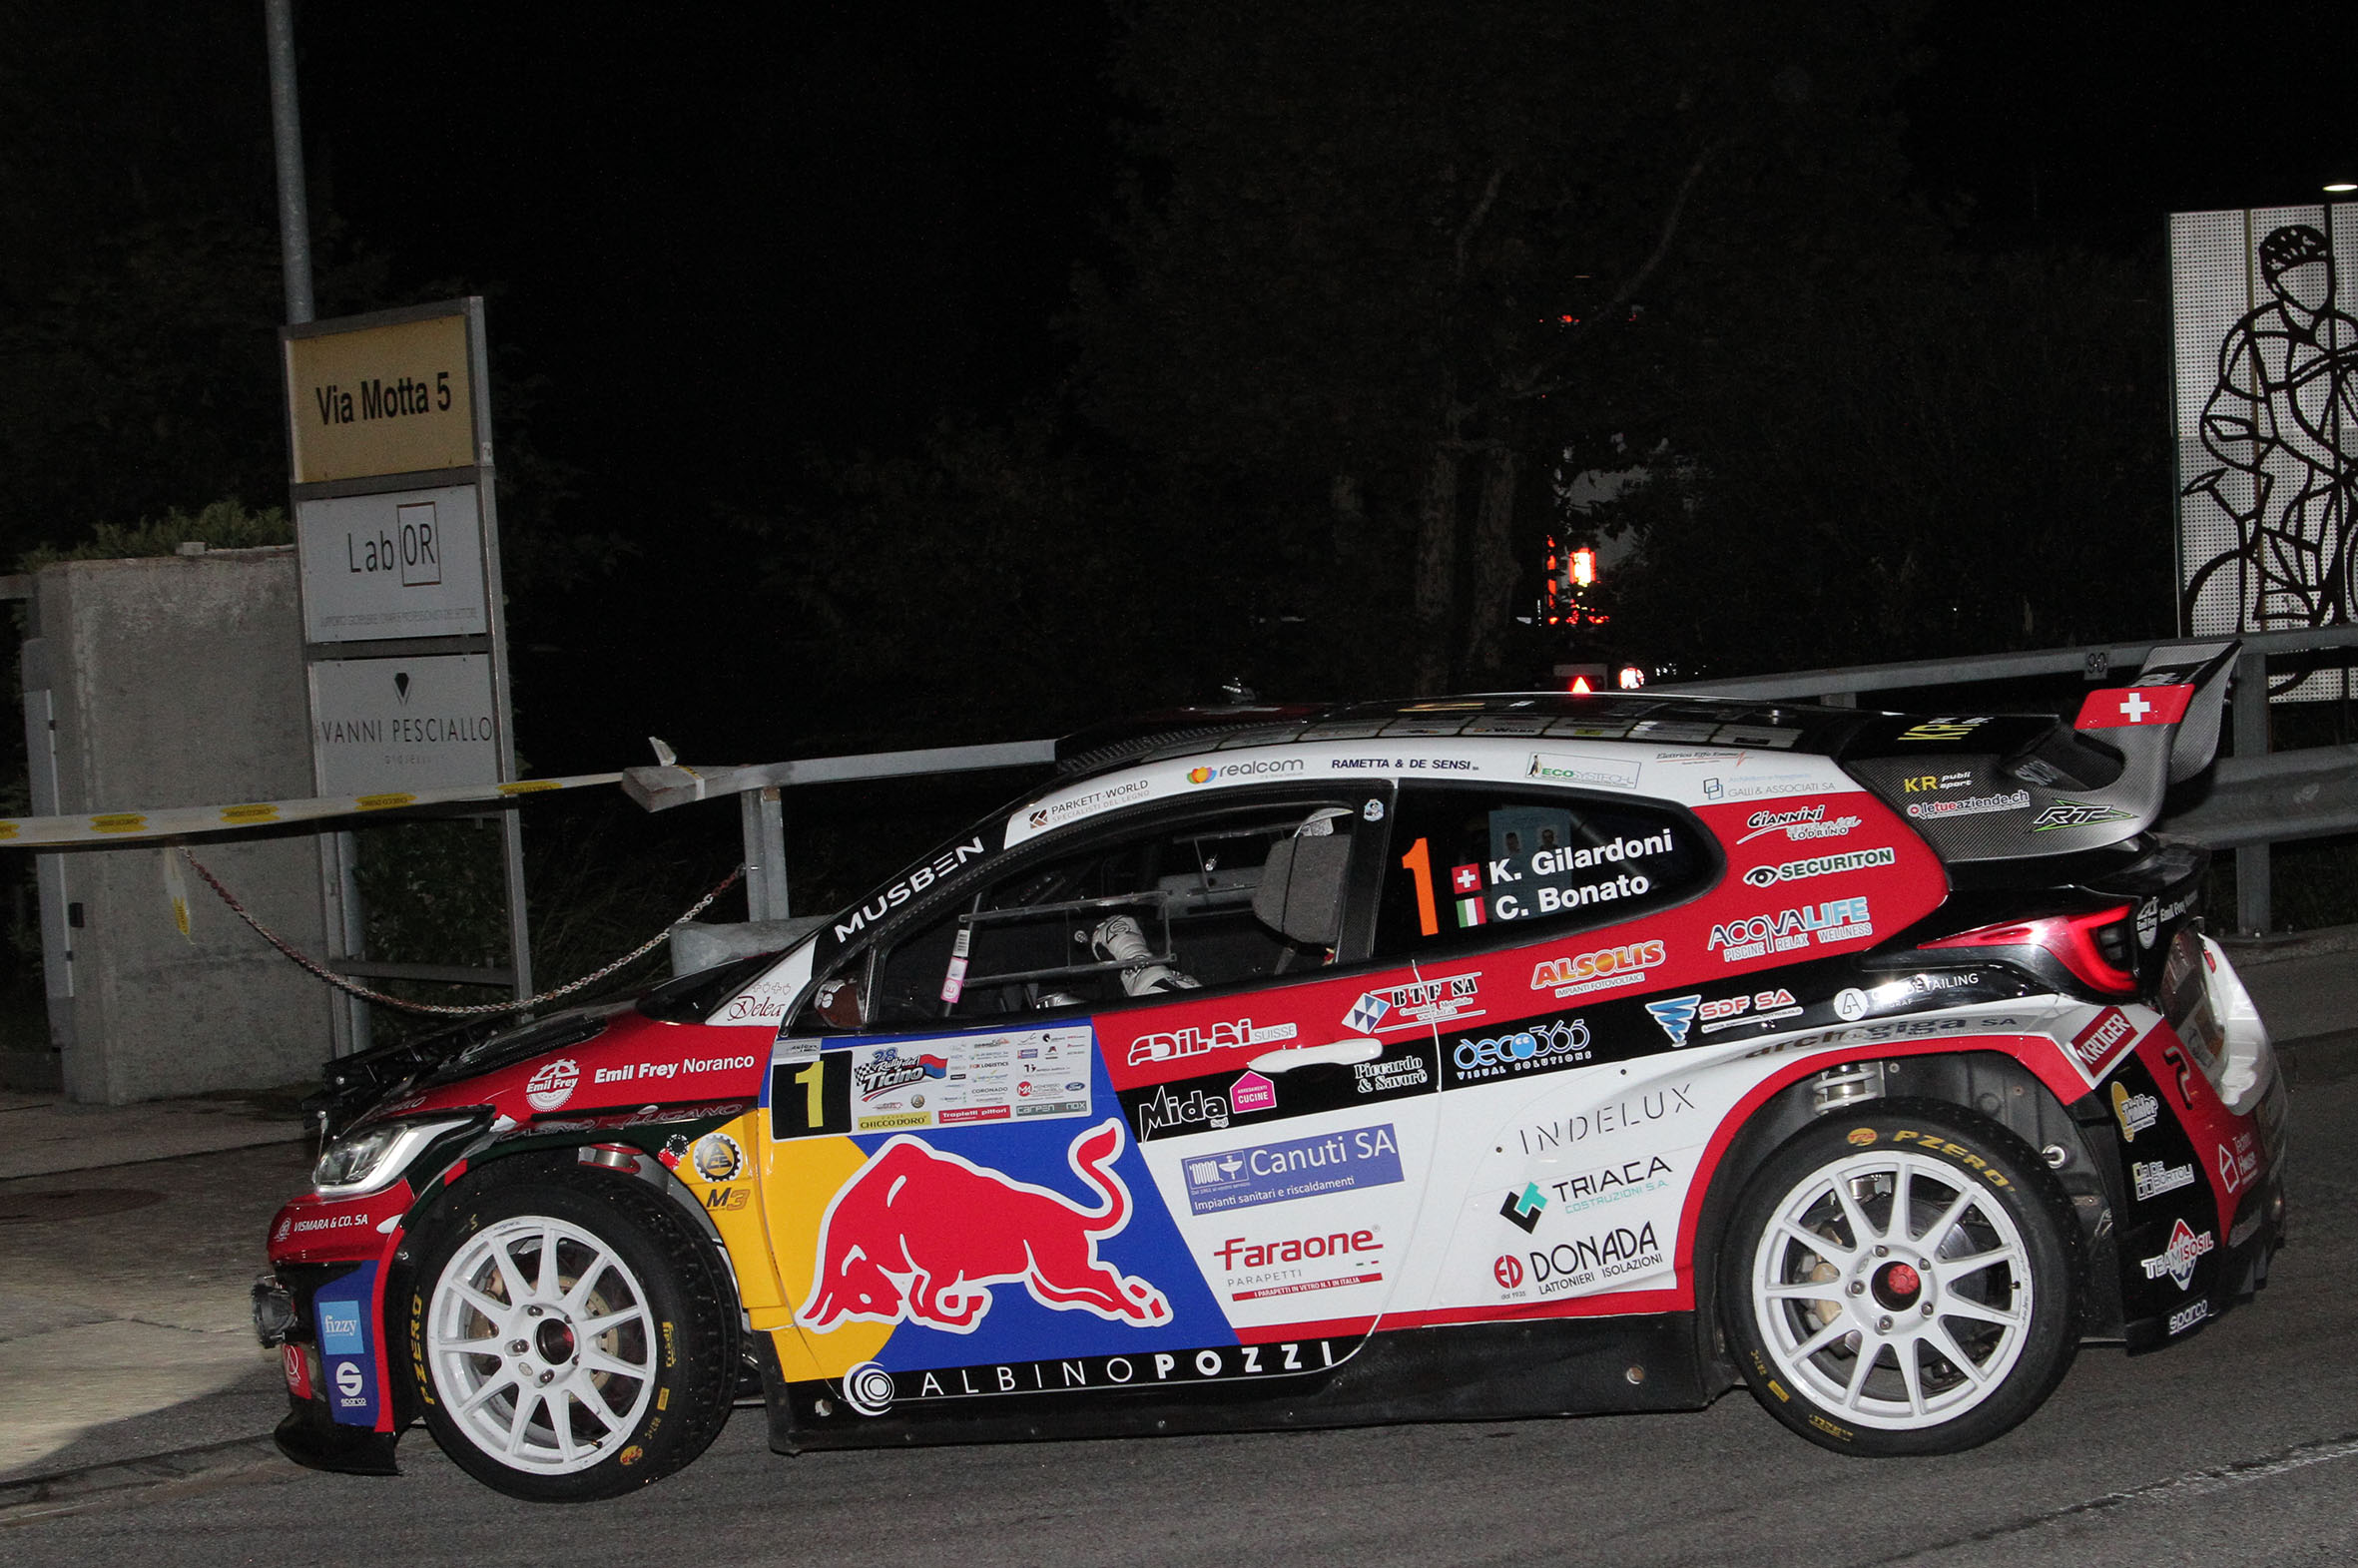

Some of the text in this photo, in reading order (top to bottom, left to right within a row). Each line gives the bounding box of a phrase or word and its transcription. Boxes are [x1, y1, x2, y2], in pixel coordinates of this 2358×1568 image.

[315, 371, 451, 425] Via Motta 5
[2087, 653, 2108, 674] 90
[321, 717, 493, 744] VANNI PESCIALLO
[1220, 758, 1304, 778] realcom
[1332, 759, 1390, 769] RAMETTA
[1395, 759, 1404, 769] &
[1410, 759, 1427, 769] DE
[1433, 760, 1472, 771] SENSI
[1942, 771, 1972, 782] publi
[1051, 780, 1149, 814] PARKETT-WORLD
[1766, 783, 1819, 794] ASSOCIATI
[1822, 783, 1836, 791] SA
[1904, 776, 1938, 793] KR
[1940, 780, 1973, 790] sport
[1052, 789, 1150, 823] SPECIALISTI DEL LEGNO
[1921, 790, 2029, 814] letueaziende.ch
[1748, 804, 1825, 829] Giannini
[1791, 825, 1848, 840] LODRINO
[1489, 828, 1673, 885] K. Gilardoni
[1781, 849, 1893, 879] SECURITON
[834, 836, 984, 944] MUSBEN
[1401, 836, 1439, 936] 1
[1495, 875, 1649, 920] C. Bonato
[1724, 924, 1872, 962] PISCINE RELAX WELLNESS
[1532, 941, 1664, 988] ALSOLIS
[1451, 978, 1477, 997] SA
[1556, 973, 1644, 997] IMPIANTI FOTOVOLTAICI
[1907, 973, 1979, 995] DETAILING
[728, 995, 786, 1022] Delea
[1701, 991, 1795, 1018] SDF SA
[1254, 1025, 1296, 1042] SUISSE
[1981, 1018, 2017, 1028] SA
[873, 1047, 898, 1063] 28
[874, 1058, 903, 1073] Rally
[1355, 1055, 1424, 1080] Piccardo
[1457, 1051, 1592, 1081] VISUAL SOLUTIONS
[595, 1055, 755, 1084] Emil Frey Noranco
[864, 1066, 925, 1094] Ticino
[526, 1077, 578, 1094] Emil Frey
[795, 1060, 825, 1129] 1
[1238, 1091, 1269, 1104] CUCINE
[1358, 1078, 1373, 1093] &
[897, 1118, 924, 1127] D'ORO
[1018, 1105, 1055, 1115] carpen
[1139, 1086, 1229, 1142] Mida
[1519, 1082, 1696, 1155] INDELUX
[1249, 1129, 1396, 1178] Canuti SA
[1892, 1129, 1919, 1143] P
[1918, 1134, 2010, 1188] ZERO
[1551, 1156, 1673, 1203] TRIACA
[2150, 1161, 2164, 1176] DE
[2154, 1164, 2193, 1187] BORTOLI
[706, 1187, 751, 1211] M3
[1194, 1192, 1237, 1212] Impianti
[1239, 1189, 1277, 1205] sanitari
[1287, 1175, 1356, 1197] riscaldamenti
[1564, 1186, 1643, 1215] COSTRUZIONI
[294, 1214, 368, 1233] VISMARA & CO. SA
[1214, 1230, 1384, 1272] faraone
[1529, 1220, 1659, 1283] DONADA
[1228, 1269, 1303, 1288] PARAPETTI
[1538, 1253, 1663, 1296] LATTONIERI ISOLAZIONI
[1258, 1287, 1291, 1298] PARAPETTI
[1340, 1277, 1361, 1287] ITALIA
[325, 1314, 357, 1336] fizzy
[2169, 1299, 2208, 1333] sparco
[409, 1293, 428, 1385] ZERO
